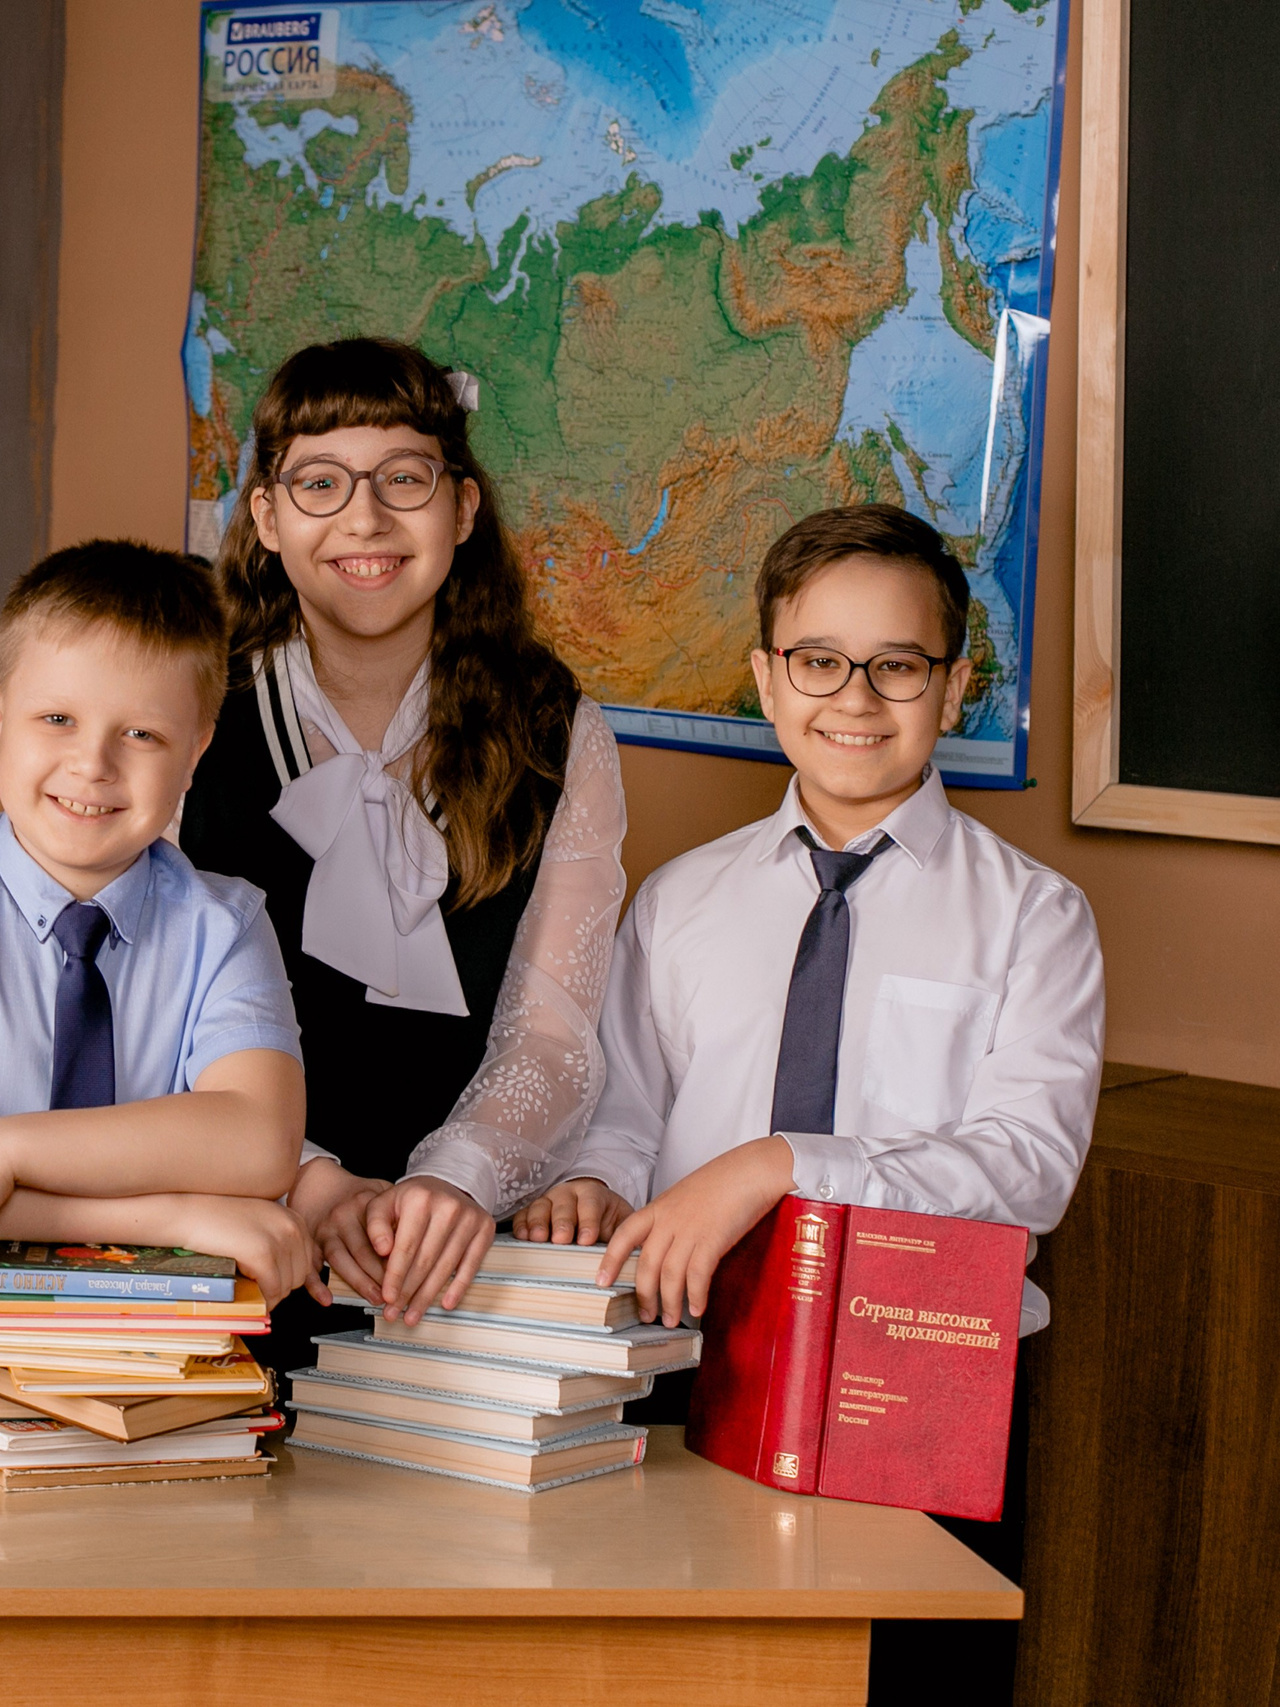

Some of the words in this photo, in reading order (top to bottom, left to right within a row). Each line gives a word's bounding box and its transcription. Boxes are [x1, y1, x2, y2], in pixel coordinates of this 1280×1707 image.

[243, 20, 311, 39] BRAUBERG
[222, 45, 320, 78] РОССИЯ
[13, 1272, 68, 1292] АСИНО
[88, 1277, 134, 1294] Михеева
[134, 1279, 173, 1296] Тамара
[849, 1295, 914, 1323] Страна
[917, 1309, 993, 1332] высоких
[886, 1323, 1002, 1350] вдохновений
[842, 1371, 885, 1387] Фольклор
[848, 1388, 909, 1403] литературные
[838, 1400, 886, 1414] памятники
[837, 1413, 869, 1426] России
